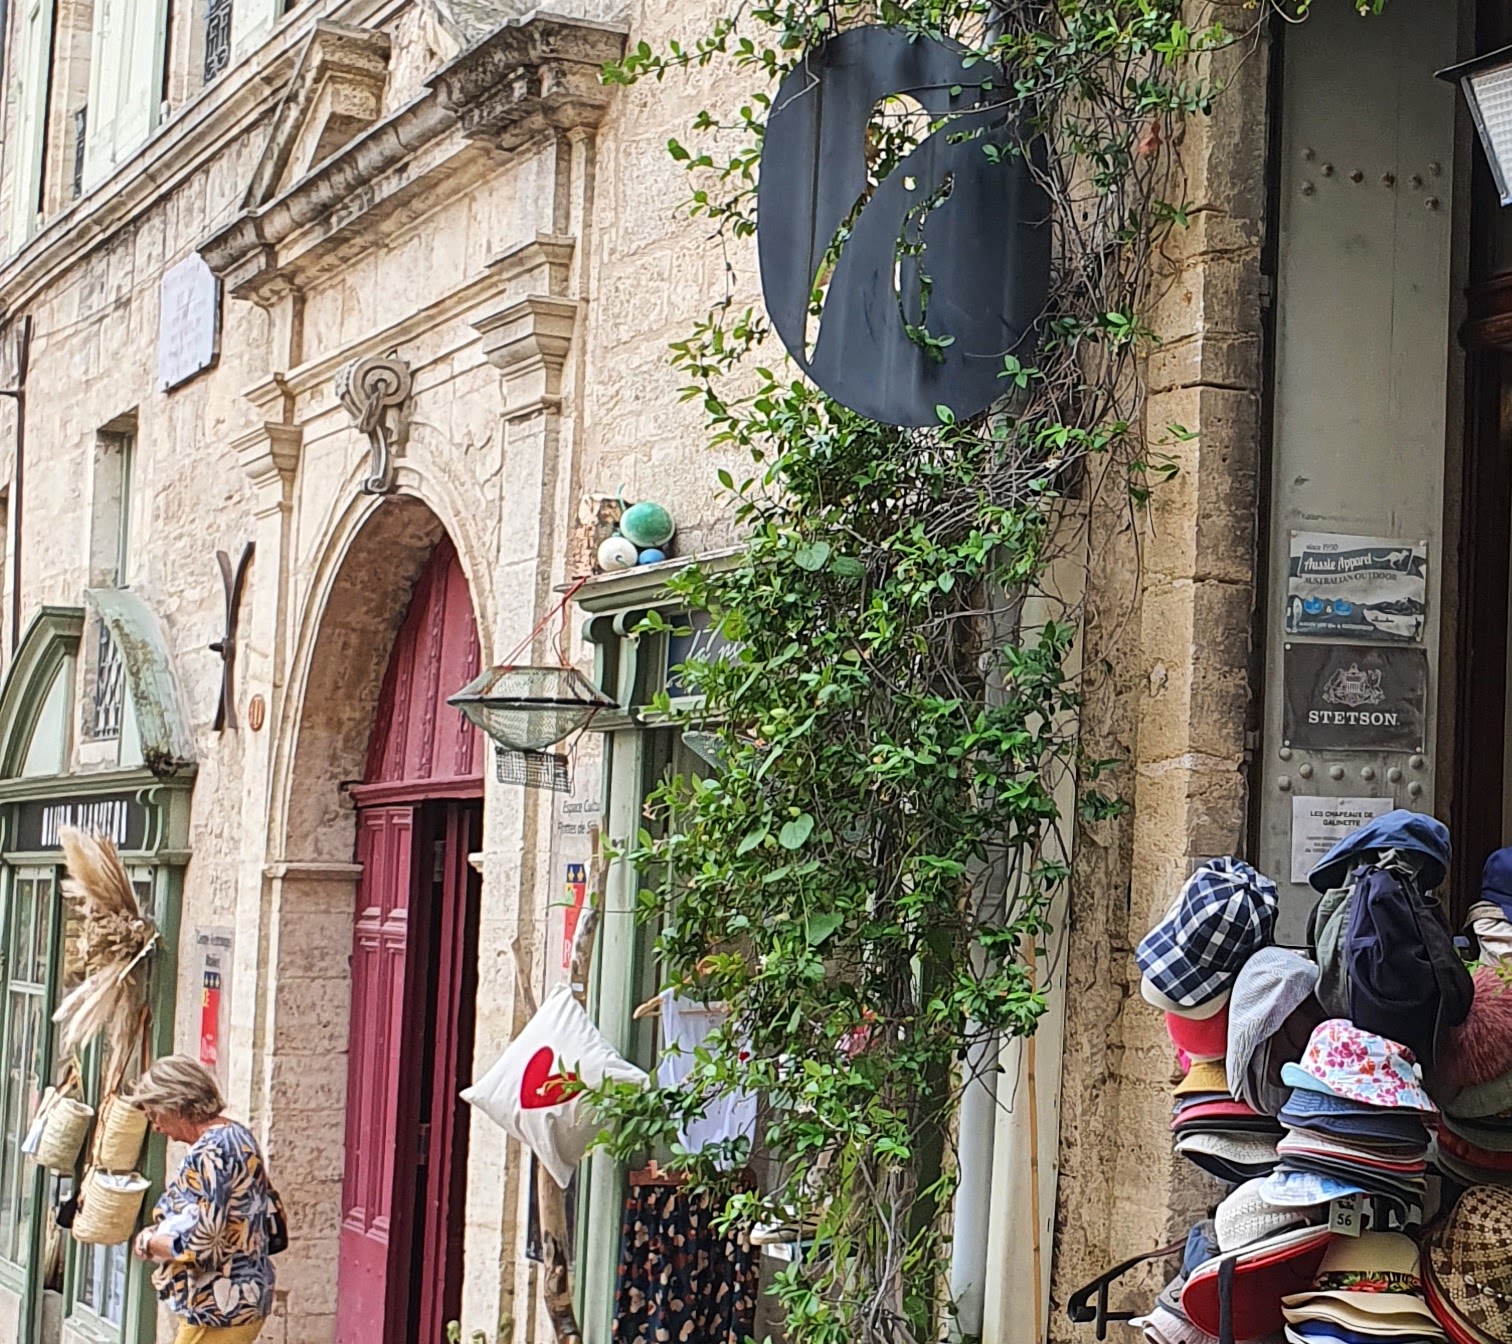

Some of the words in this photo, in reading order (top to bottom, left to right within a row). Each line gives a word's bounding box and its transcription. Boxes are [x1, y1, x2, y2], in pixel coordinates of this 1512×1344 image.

[1304, 557, 1336, 572] Aussie
[1303, 573, 1355, 585] AUSTRALIAN
[1354, 570, 1398, 582] OUTDOOR
[1308, 710, 1398, 726] STETSON
[1363, 811, 1374, 819] DE
[1336, 1213, 1352, 1226] 56
